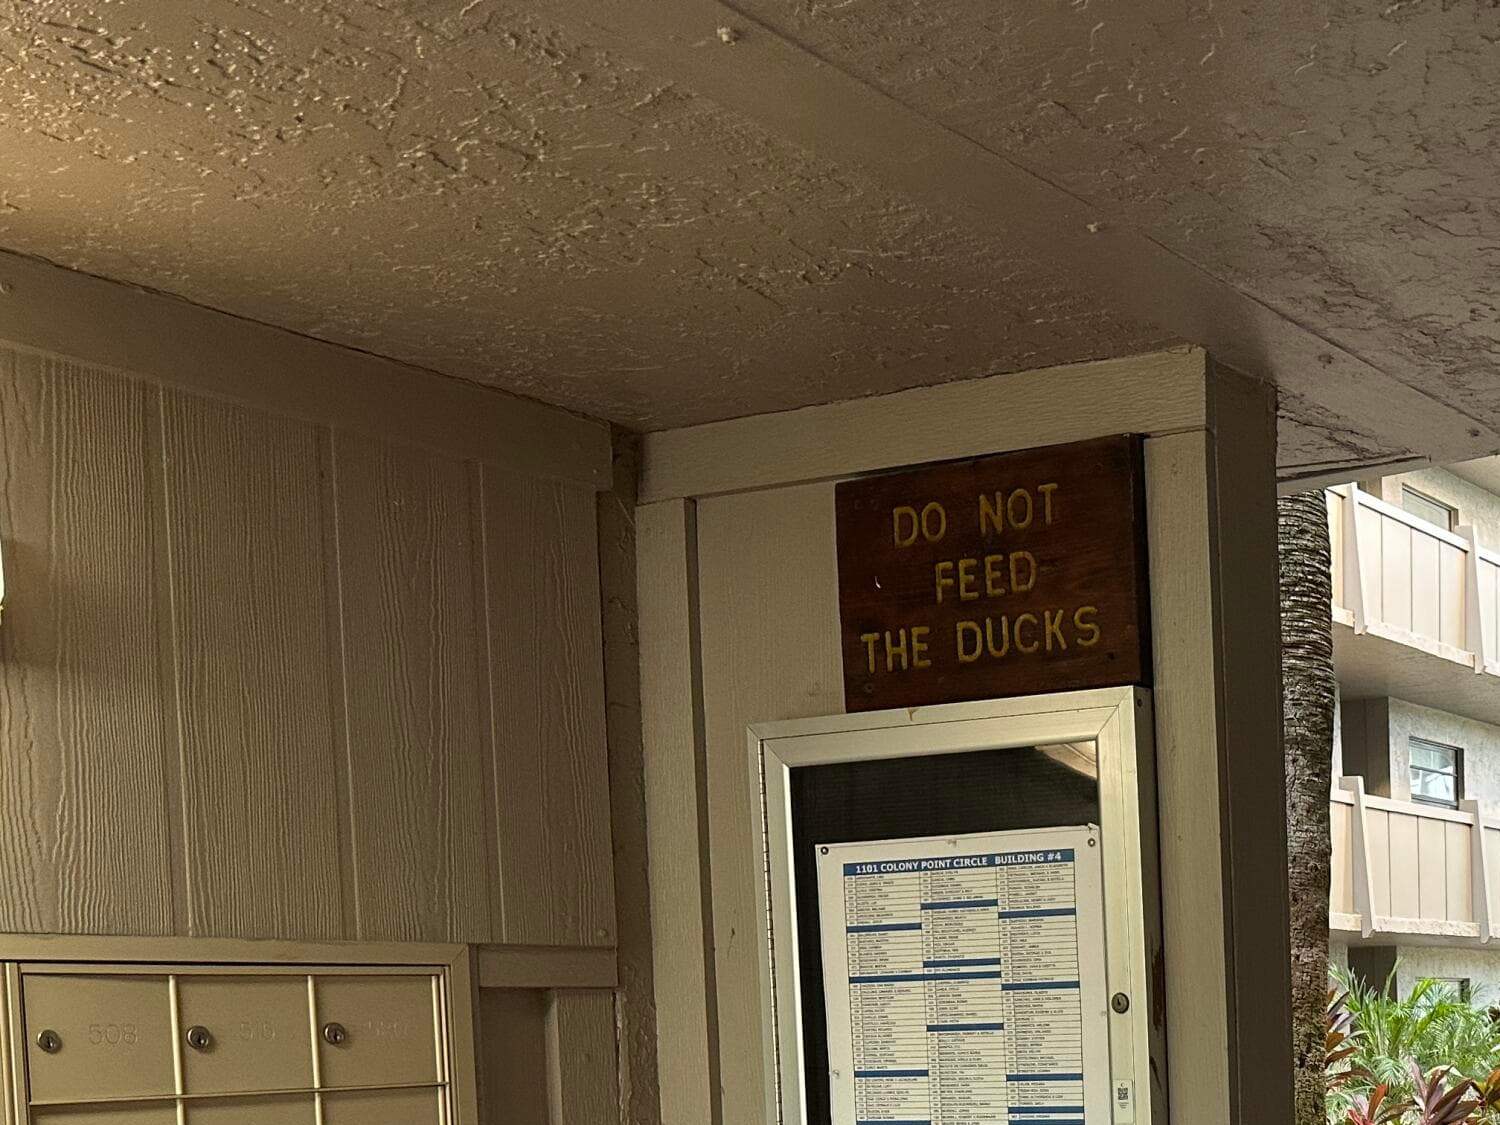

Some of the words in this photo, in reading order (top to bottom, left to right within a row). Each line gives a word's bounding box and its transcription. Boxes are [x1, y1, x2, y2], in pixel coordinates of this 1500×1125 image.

[892, 501, 947, 549] DO
[978, 482, 1059, 537] NOT
[934, 550, 1038, 604] FEED
[860, 625, 932, 674] THE
[956, 605, 1100, 664] DUCKS
[855, 862, 879, 874] 1101
[880, 860, 919, 873] COLONY
[921, 859, 952, 871] POINT
[953, 856, 988, 869] CIRCLE
[994, 853, 1044, 865] BUILDING
[1047, 851, 1062, 862] #4
[88, 1021, 140, 1047] 508
